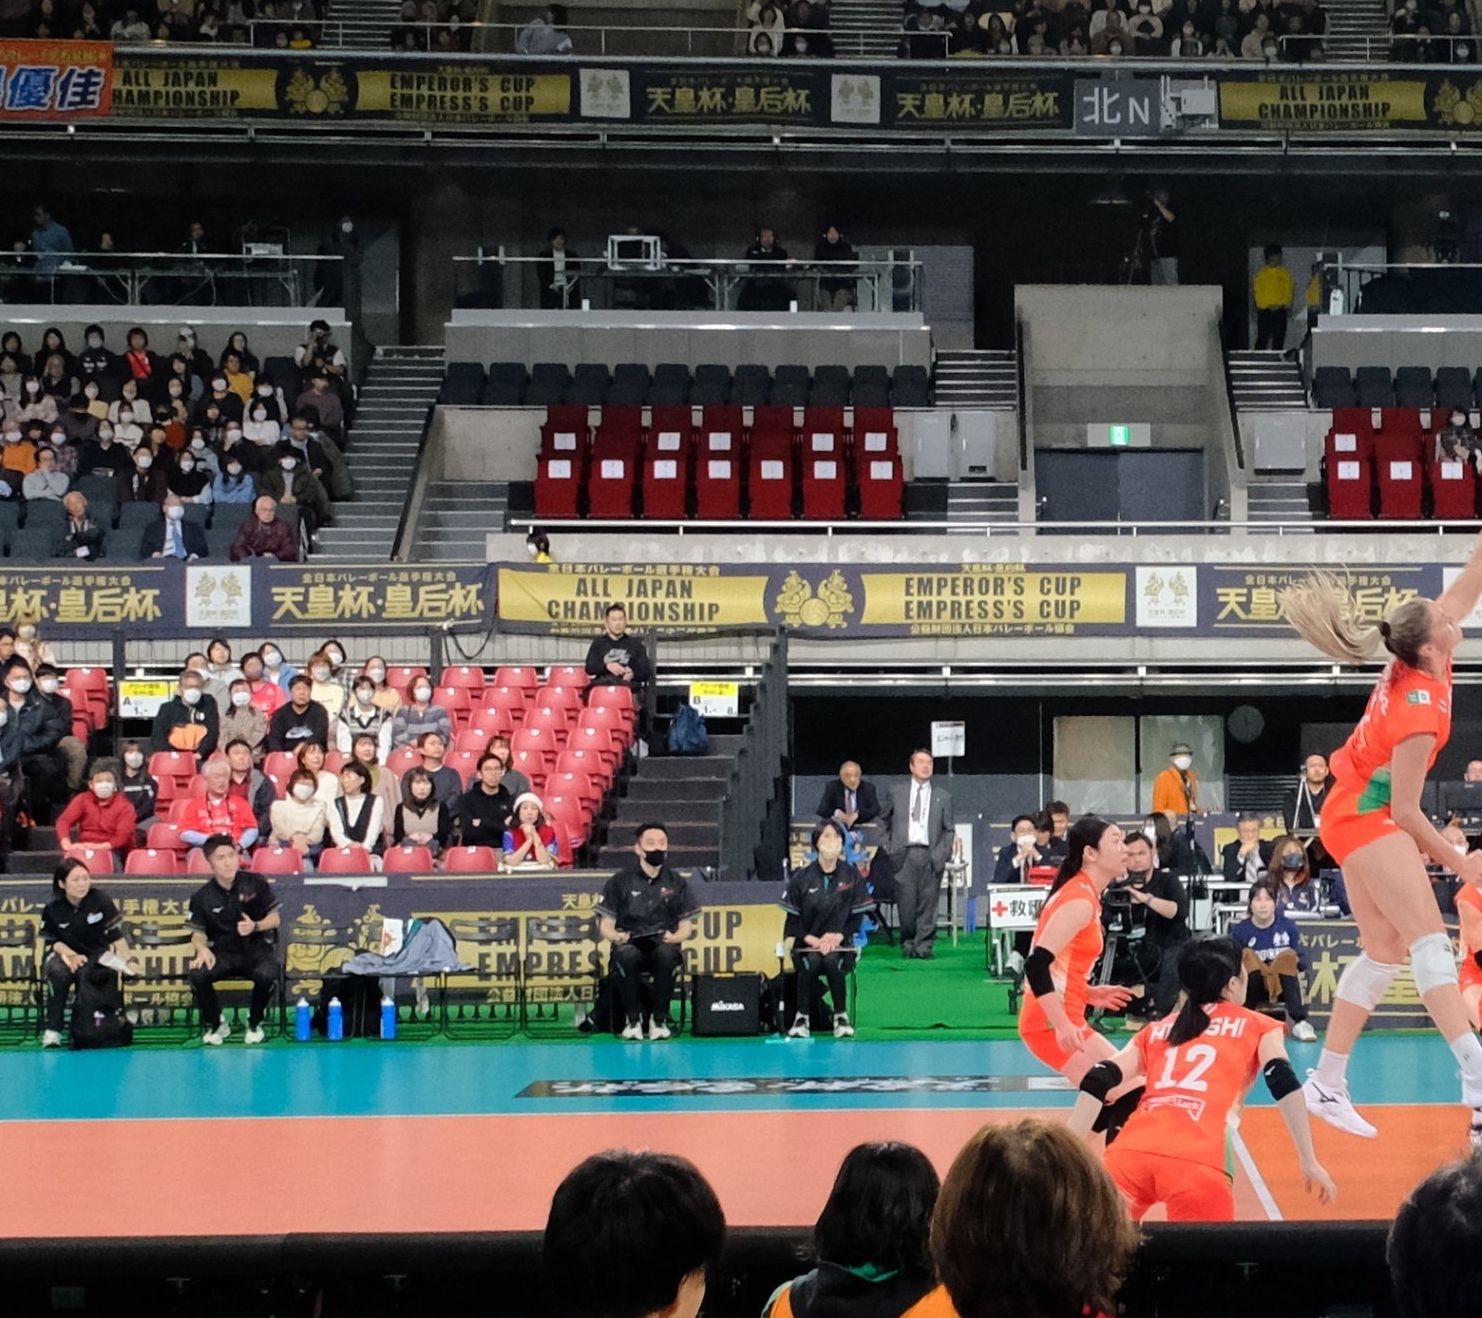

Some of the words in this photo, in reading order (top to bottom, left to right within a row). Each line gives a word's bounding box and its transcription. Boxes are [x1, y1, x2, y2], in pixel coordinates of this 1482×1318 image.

[122, 71, 150, 87] ALL
[163, 71, 218, 87] JAPAN
[391, 74, 488, 92] EMPEROR'S
[500, 74, 535, 92] CUP
[111, 91, 241, 105] HAMPIONSHIP
[1279, 85, 1308, 101] ALL
[1318, 85, 1371, 101] JAPAN
[391, 94, 488, 111] EMPRESS'S
[501, 94, 535, 111] CUP
[1083, 87, 1122, 124] 北
[1129, 97, 1150, 124] N
[1258, 103, 1391, 120] CHAMPIONSHIP
[302, 571, 456, 583] 全日本バレーボール選手権大会
[575, 578, 611, 598] ALL
[626, 578, 693, 598] JAPAN
[904, 576, 1025, 597] EMPEROR'S
[1039, 577, 1082, 597] CUP
[547, 601, 720, 622] CHAMIONSHIP
[904, 600, 1025, 621] EMPRESS'S
[1039, 600, 1082, 621] CUP
[910, 624, 1075, 635] 公益財団法人日本バレーボール協会
[692, 696, 701, 705] B
[1154, 1044, 1218, 1092] 12
